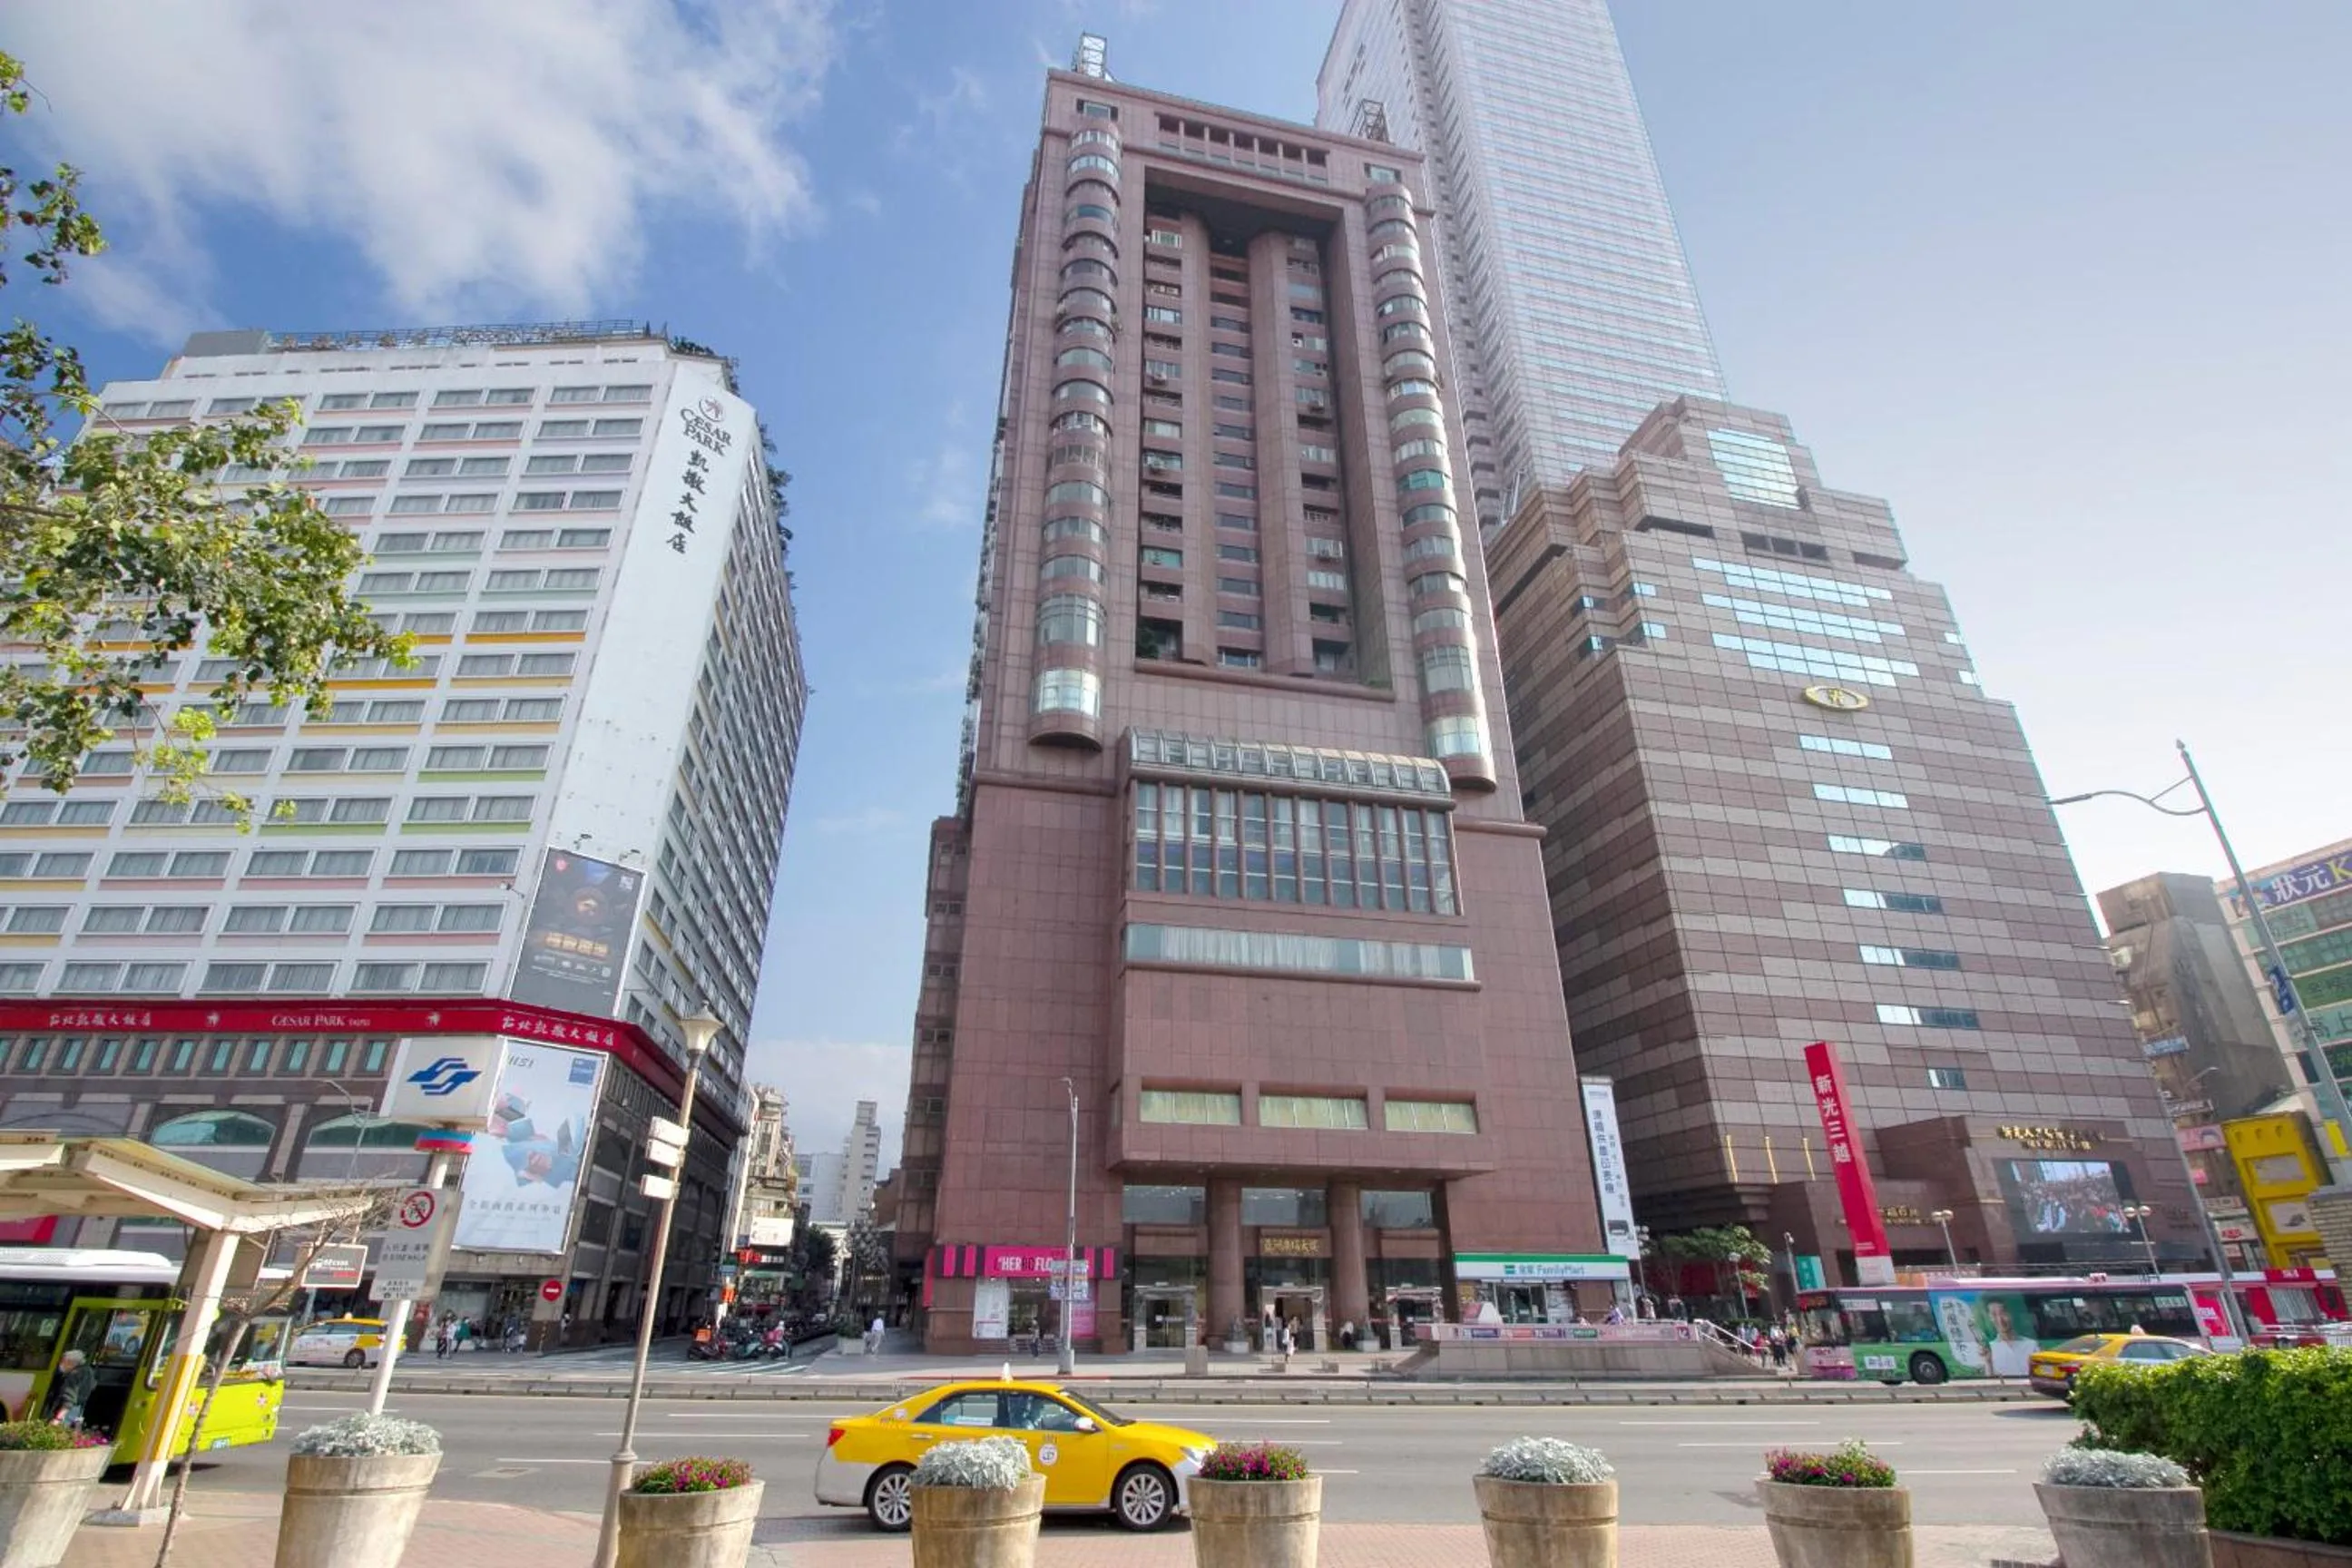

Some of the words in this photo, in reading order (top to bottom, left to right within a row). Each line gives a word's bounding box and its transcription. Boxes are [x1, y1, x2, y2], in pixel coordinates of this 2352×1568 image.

[683, 424, 725, 456] PARK
[666, 449, 710, 554] 凱撒大飯店
[313, 1014, 346, 1027] PARK
[1816, 1074, 1852, 1163] 新光三越
[1537, 1265, 1584, 1278] FamilyMart
